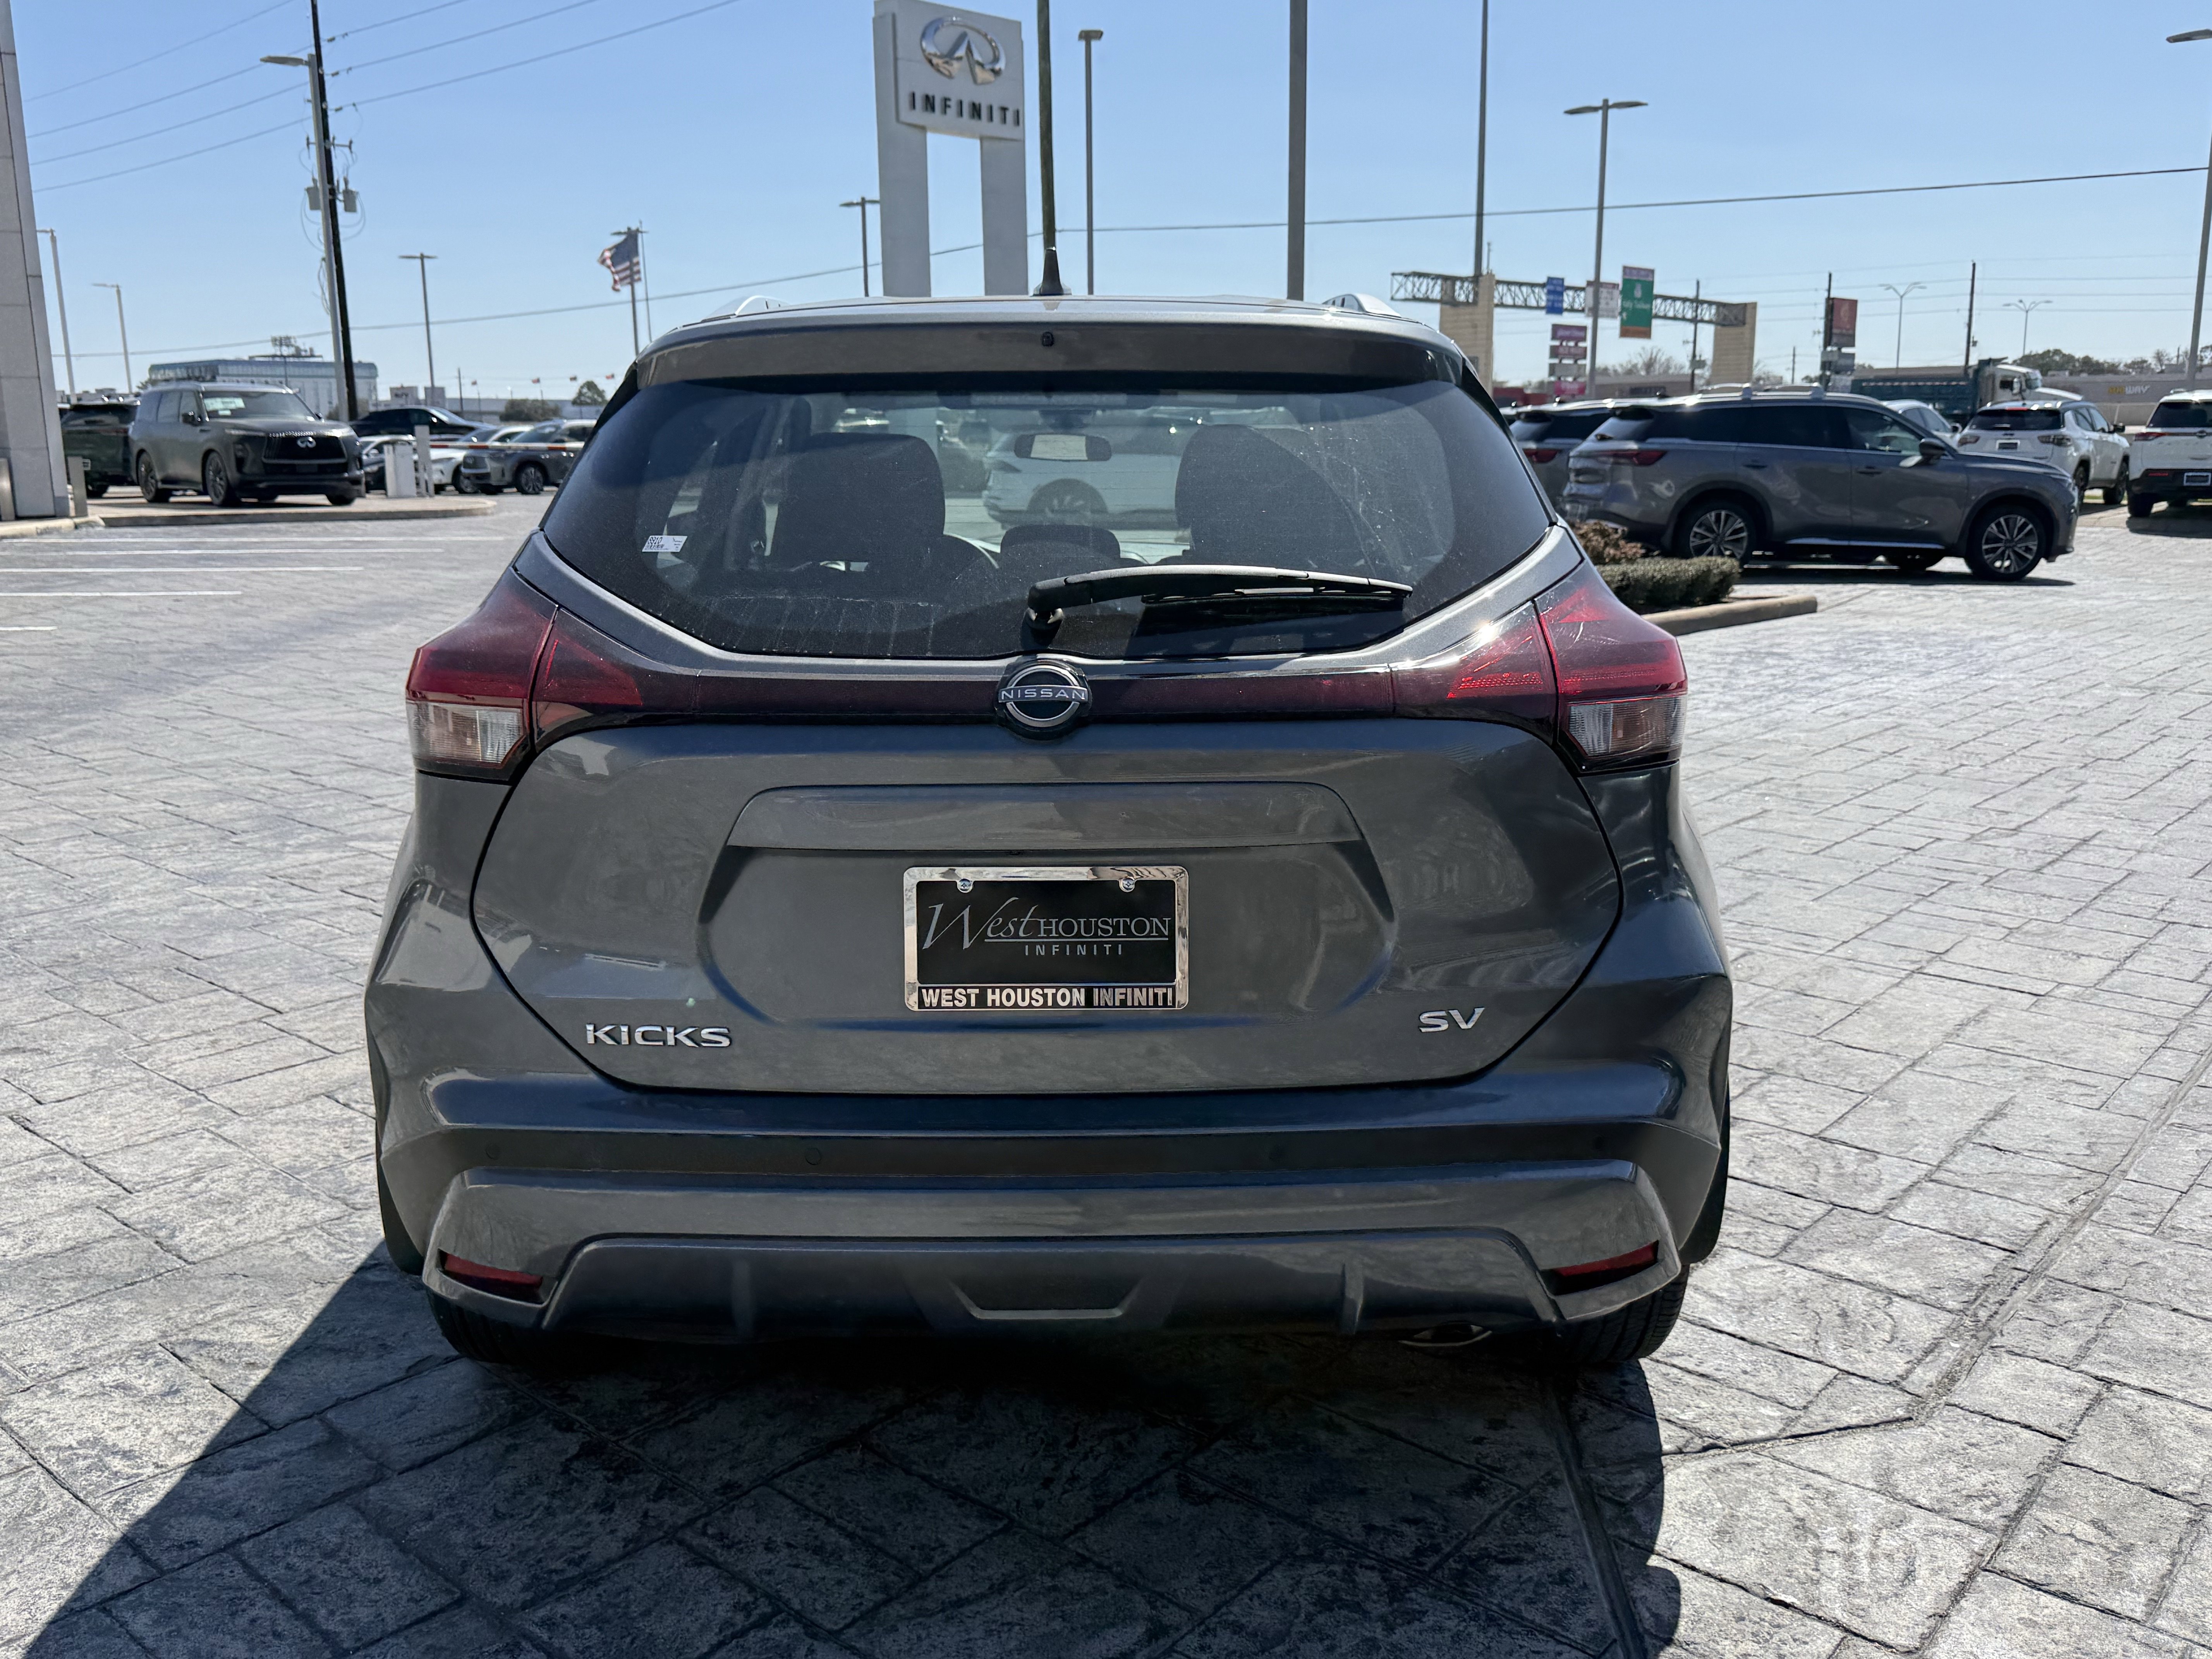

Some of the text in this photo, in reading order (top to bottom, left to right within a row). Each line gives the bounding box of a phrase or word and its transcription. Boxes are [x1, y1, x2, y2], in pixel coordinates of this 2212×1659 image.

[910, 90, 1020, 127] INFINITI
[1001, 688, 1085, 700] NISSAN
[922, 897, 1171, 950] West HOUSTON
[1025, 944, 1123, 956] INFINITI
[921, 987, 1173, 1007] WEST HOUSTON INFINITI
[1418, 1006, 1485, 1032] SV
[586, 1023, 732, 1048] KICKS
